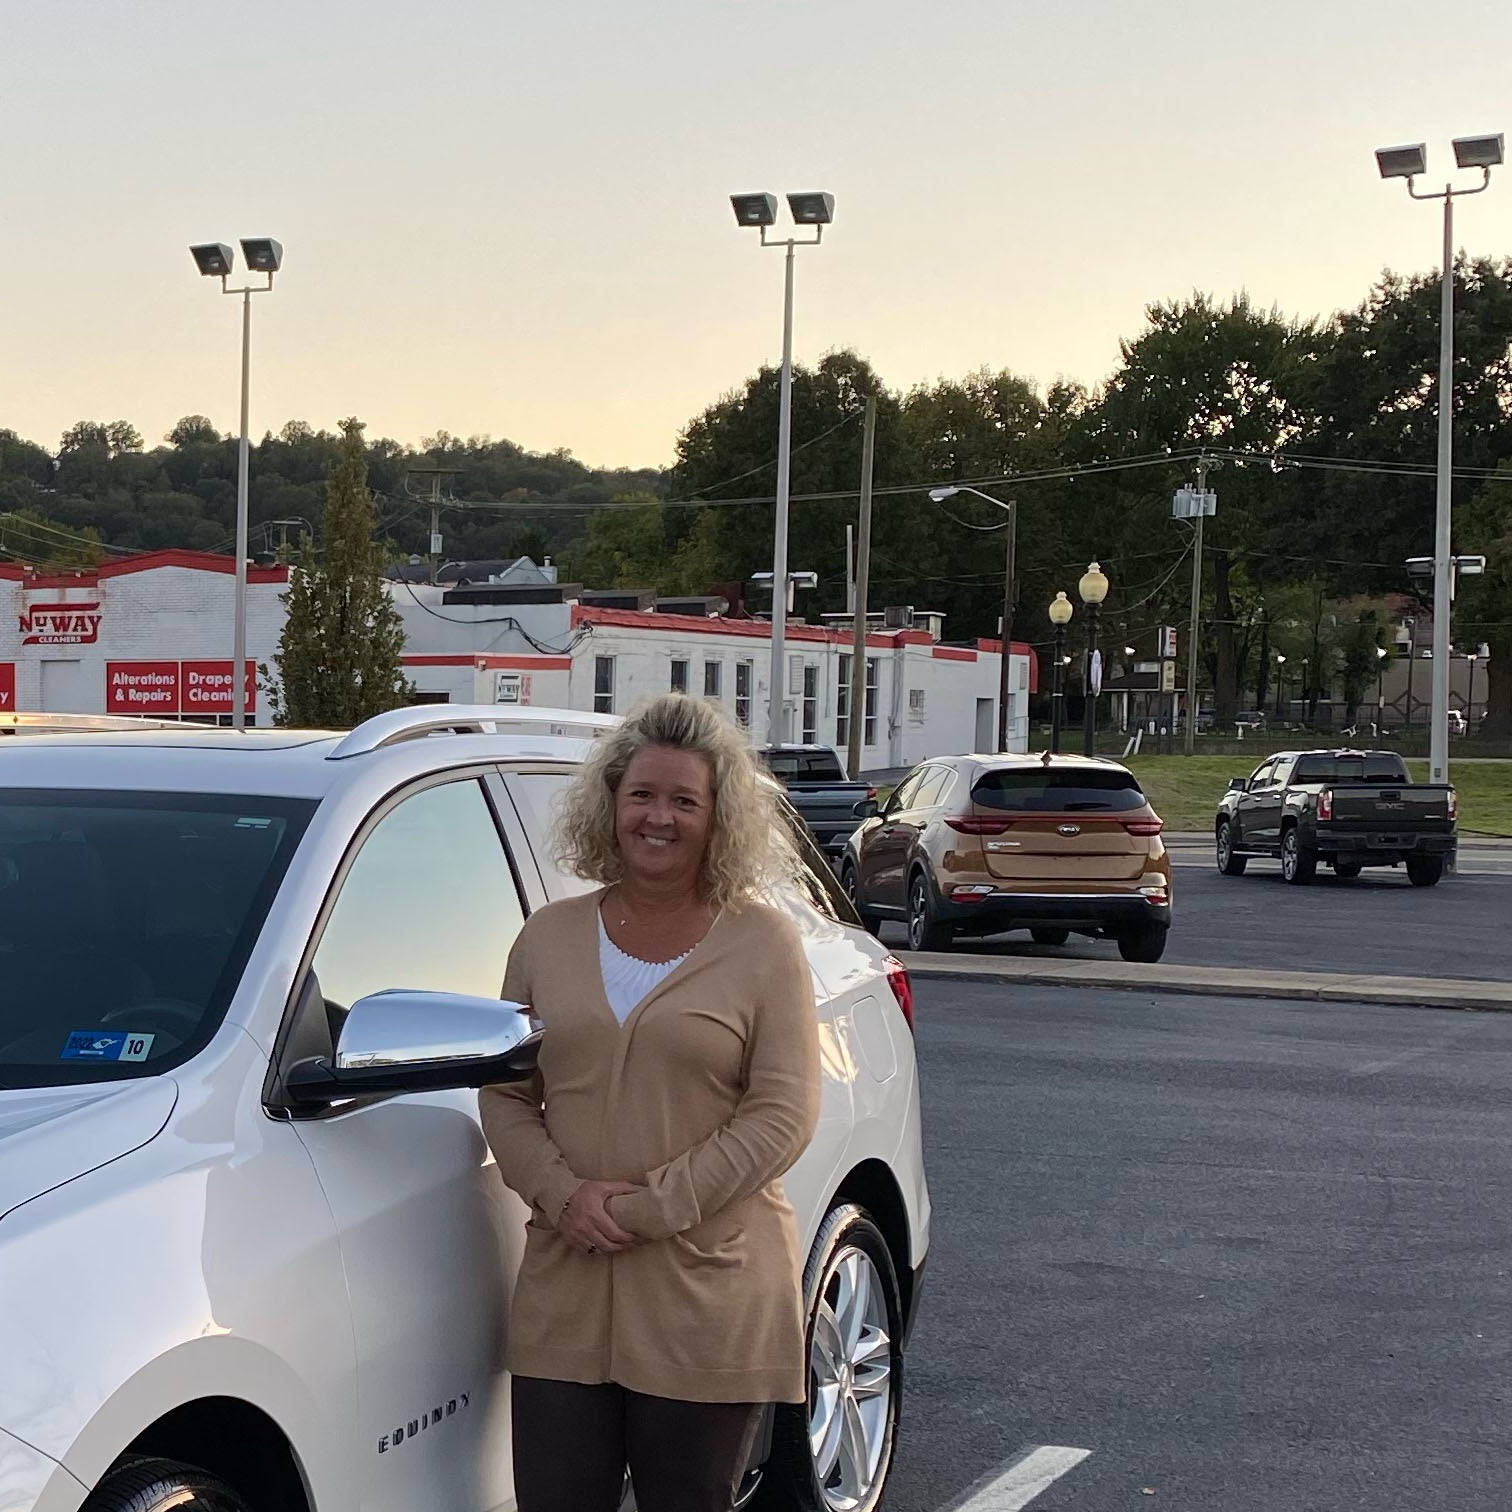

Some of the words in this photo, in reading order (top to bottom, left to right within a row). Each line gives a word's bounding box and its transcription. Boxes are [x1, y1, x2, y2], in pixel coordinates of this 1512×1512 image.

[112, 672, 175, 685] Alterations
[115, 690, 124, 701] &
[129, 689, 172, 704] Repairs
[128, 1040, 145, 1055] 10
